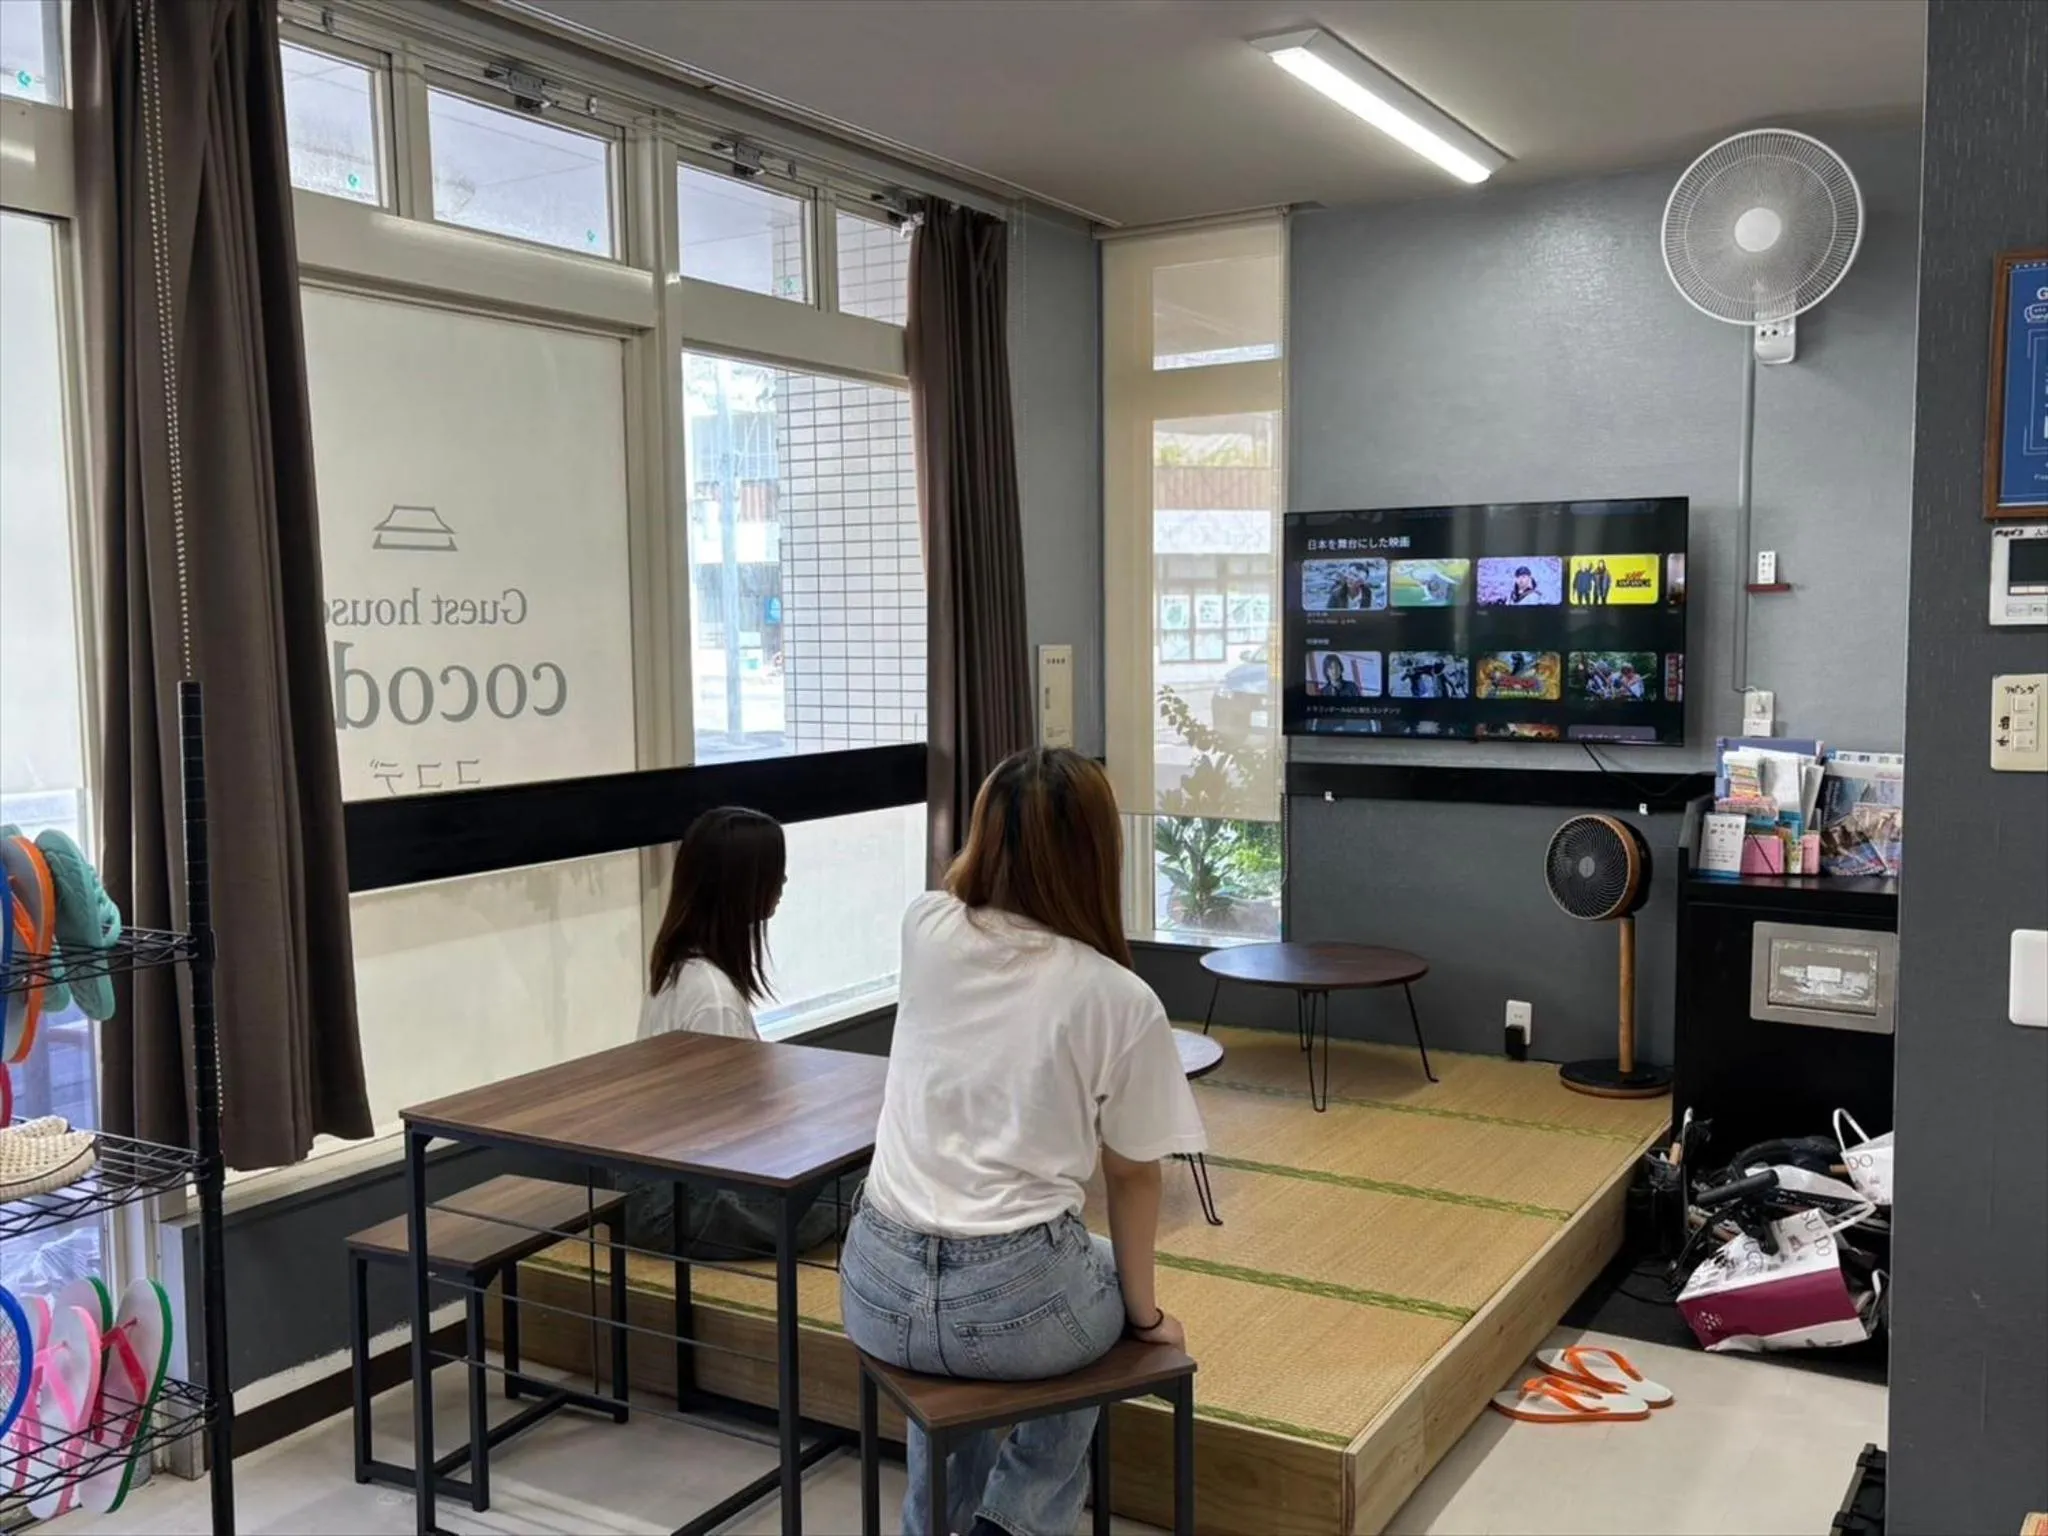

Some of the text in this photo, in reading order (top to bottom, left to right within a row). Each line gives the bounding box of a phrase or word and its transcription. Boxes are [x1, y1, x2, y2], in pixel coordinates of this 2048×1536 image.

[1307, 536, 1411, 551] 日本を舞台にした映画
